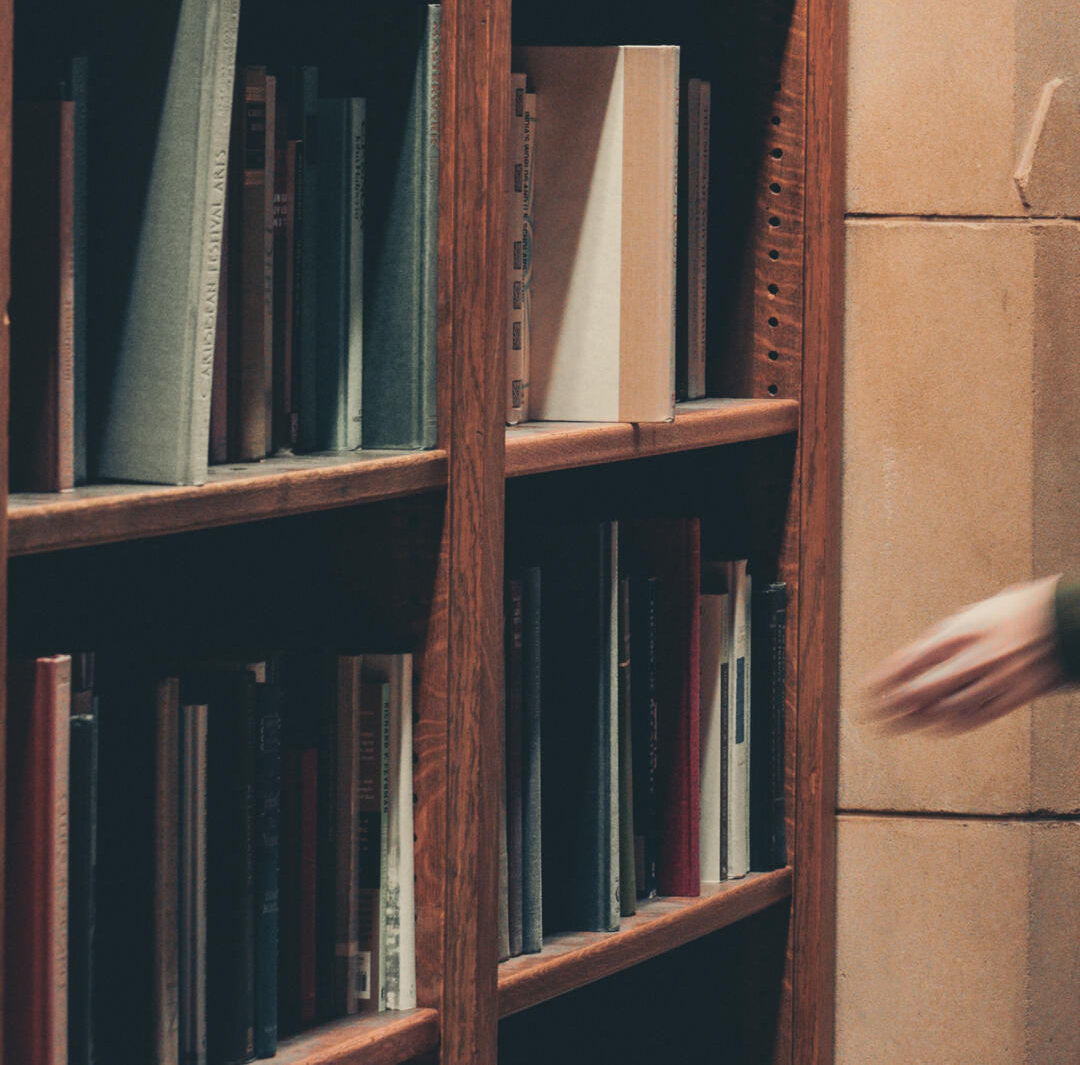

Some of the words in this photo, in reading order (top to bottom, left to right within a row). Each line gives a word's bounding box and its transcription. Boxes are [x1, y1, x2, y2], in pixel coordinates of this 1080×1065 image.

[213, 148, 226, 193] ARTS
[207, 201, 222, 273] FESTIVAL
[200, 282, 217, 400] CARIBBEAN
